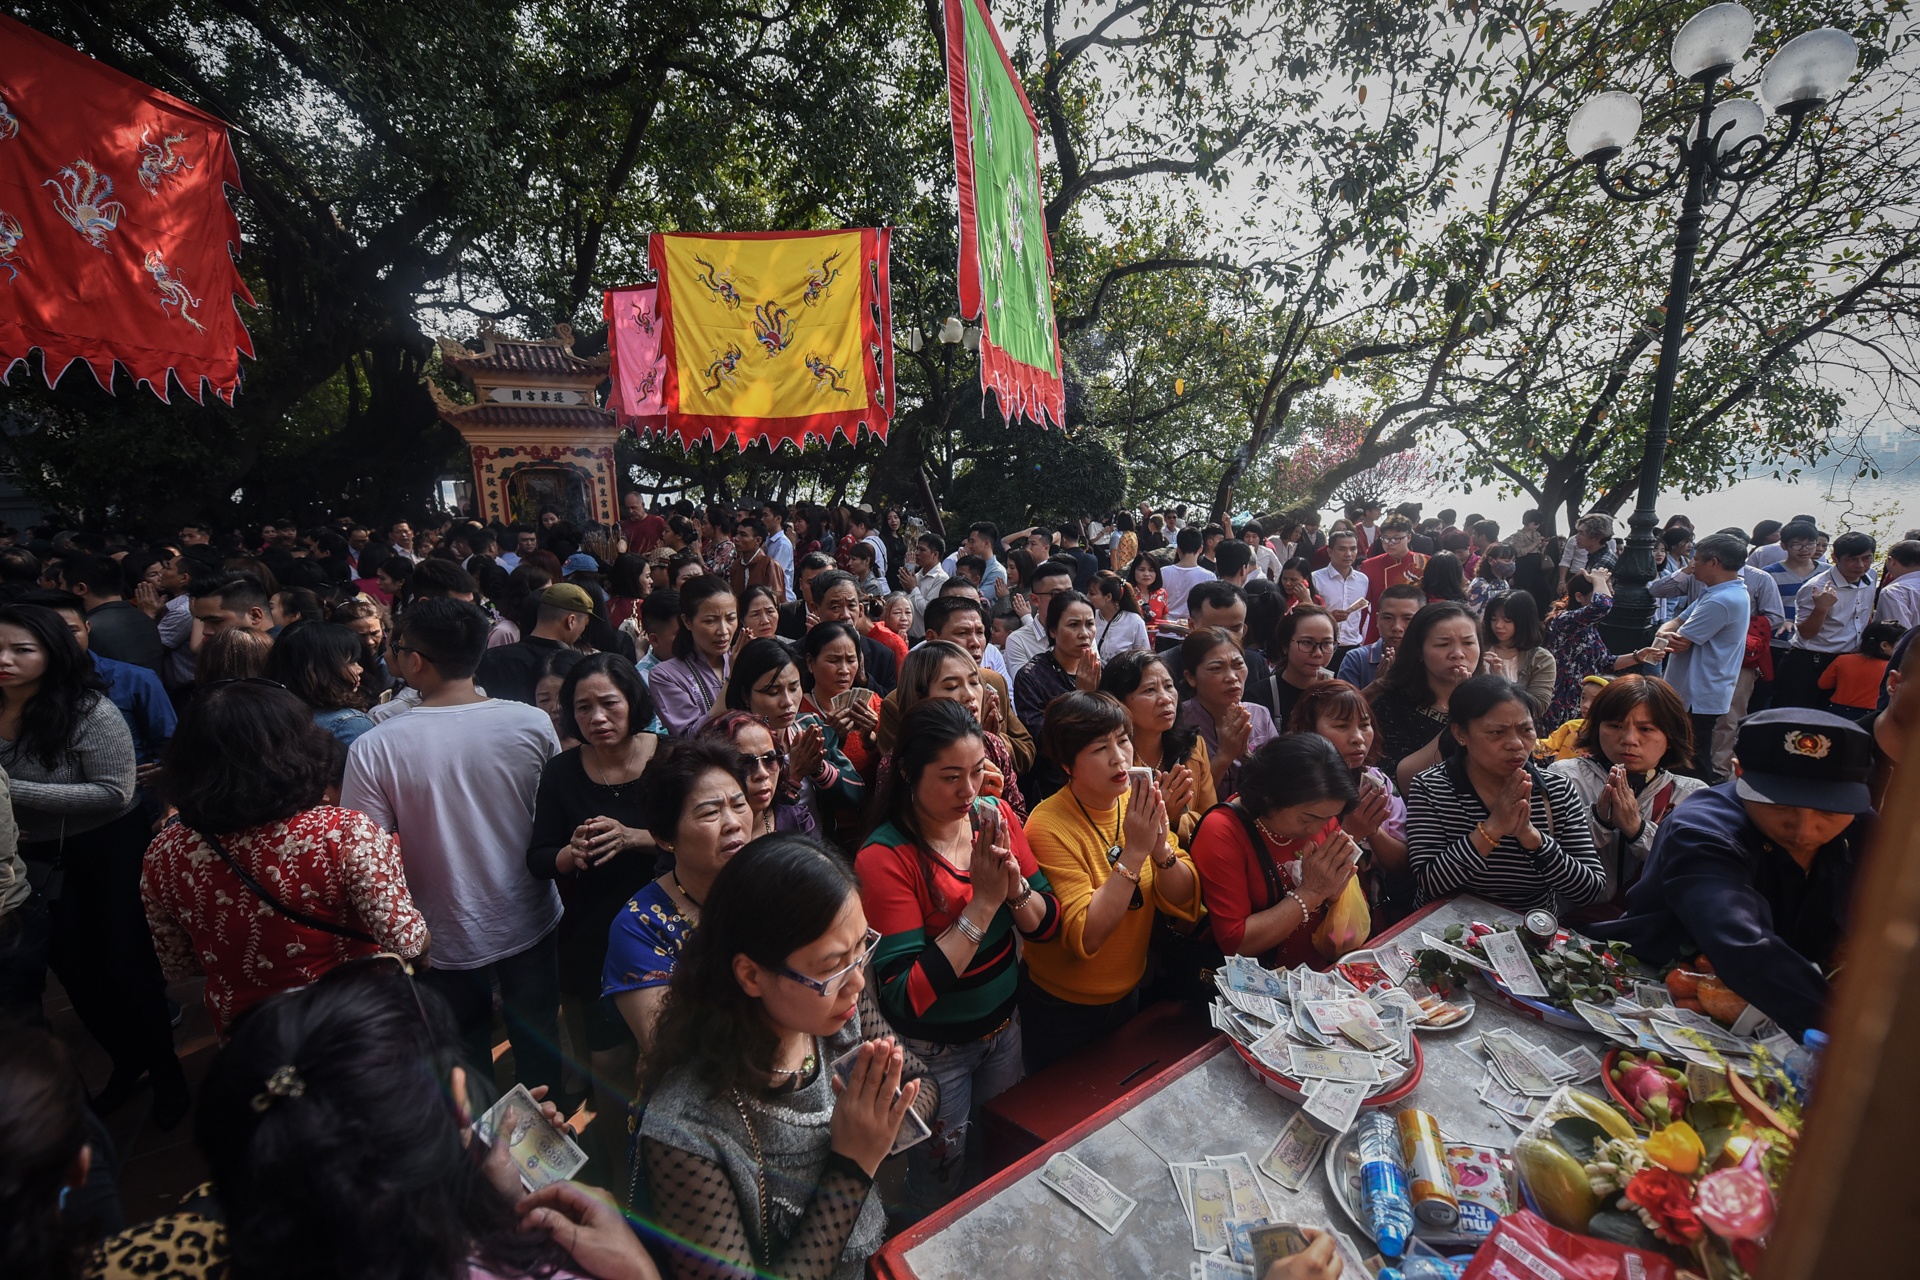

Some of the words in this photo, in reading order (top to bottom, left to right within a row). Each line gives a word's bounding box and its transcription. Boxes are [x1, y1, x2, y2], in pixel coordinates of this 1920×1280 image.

[1458, 1205, 1487, 1220] Fru
[1462, 1217, 1493, 1231] mu
[1206, 1260, 1223, 1270] 5000
